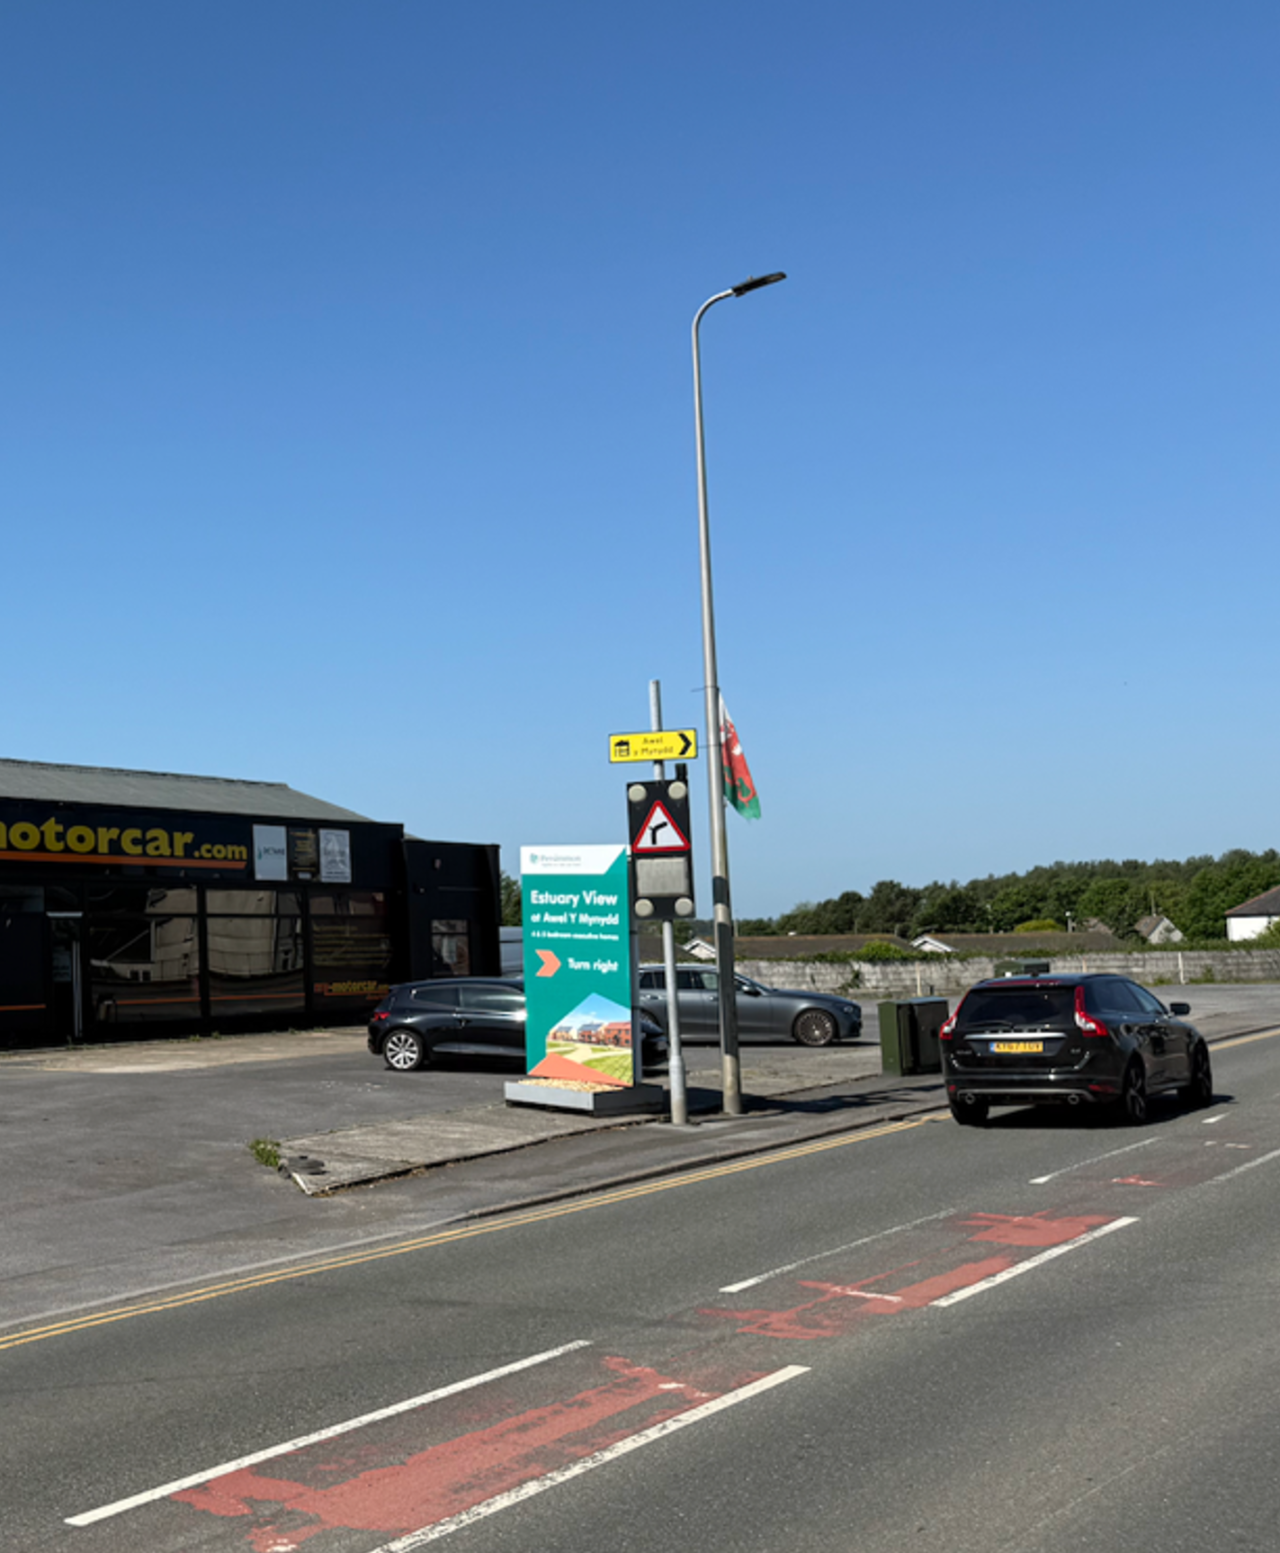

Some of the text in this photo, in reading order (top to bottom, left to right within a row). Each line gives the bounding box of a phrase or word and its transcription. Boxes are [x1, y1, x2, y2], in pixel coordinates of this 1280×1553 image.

[530, 889, 618, 908] Estuary View
[530, 911, 620, 927] at Awel Y Mynydd
[567, 957, 619, 974] Turn right
